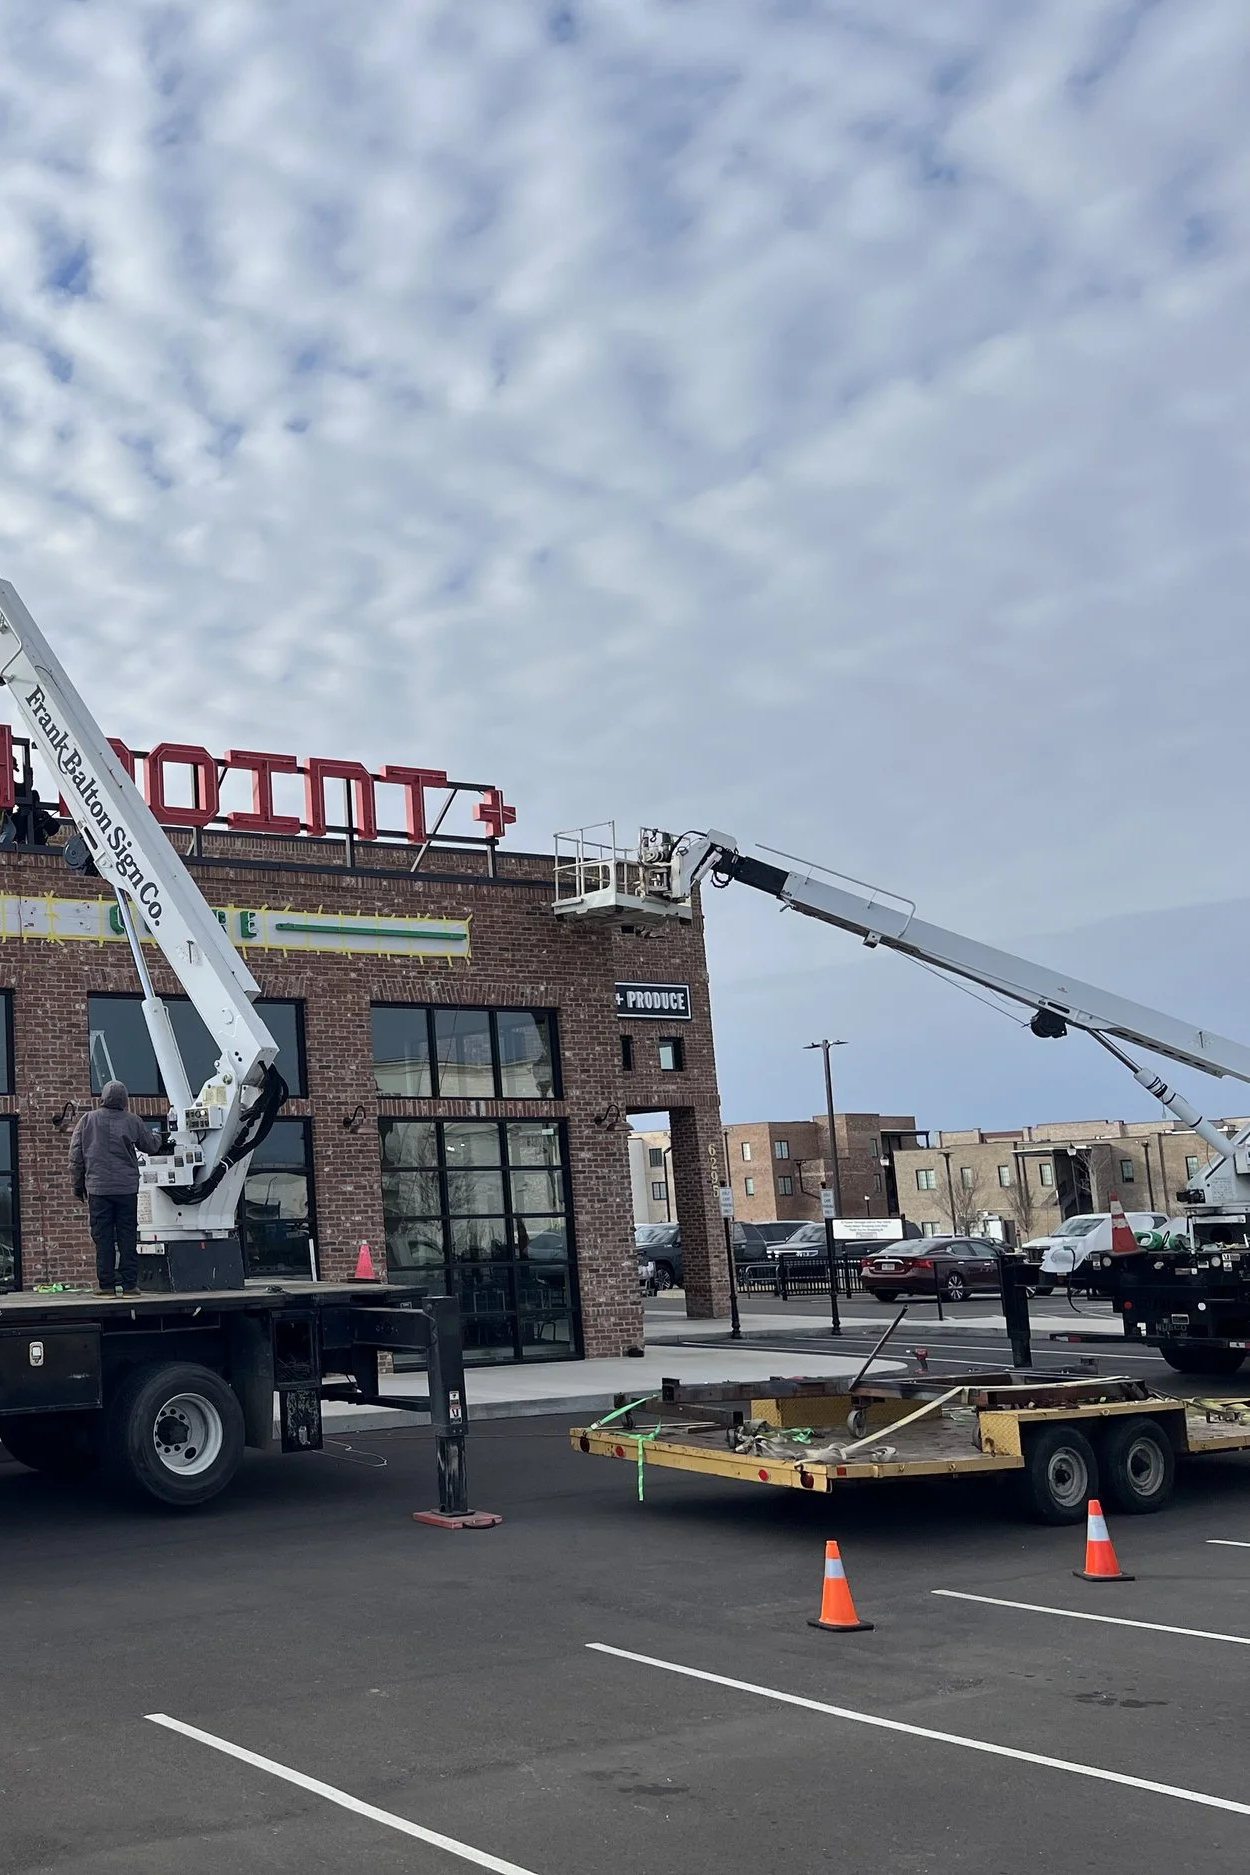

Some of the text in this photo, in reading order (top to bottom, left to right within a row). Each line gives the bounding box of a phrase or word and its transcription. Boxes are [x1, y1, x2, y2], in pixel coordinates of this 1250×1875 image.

[24, 684, 162, 927] Frank Balton Sign Co.
[626, 990, 686, 1010] PRODUCE
[707, 1143, 720, 1198] 6295
